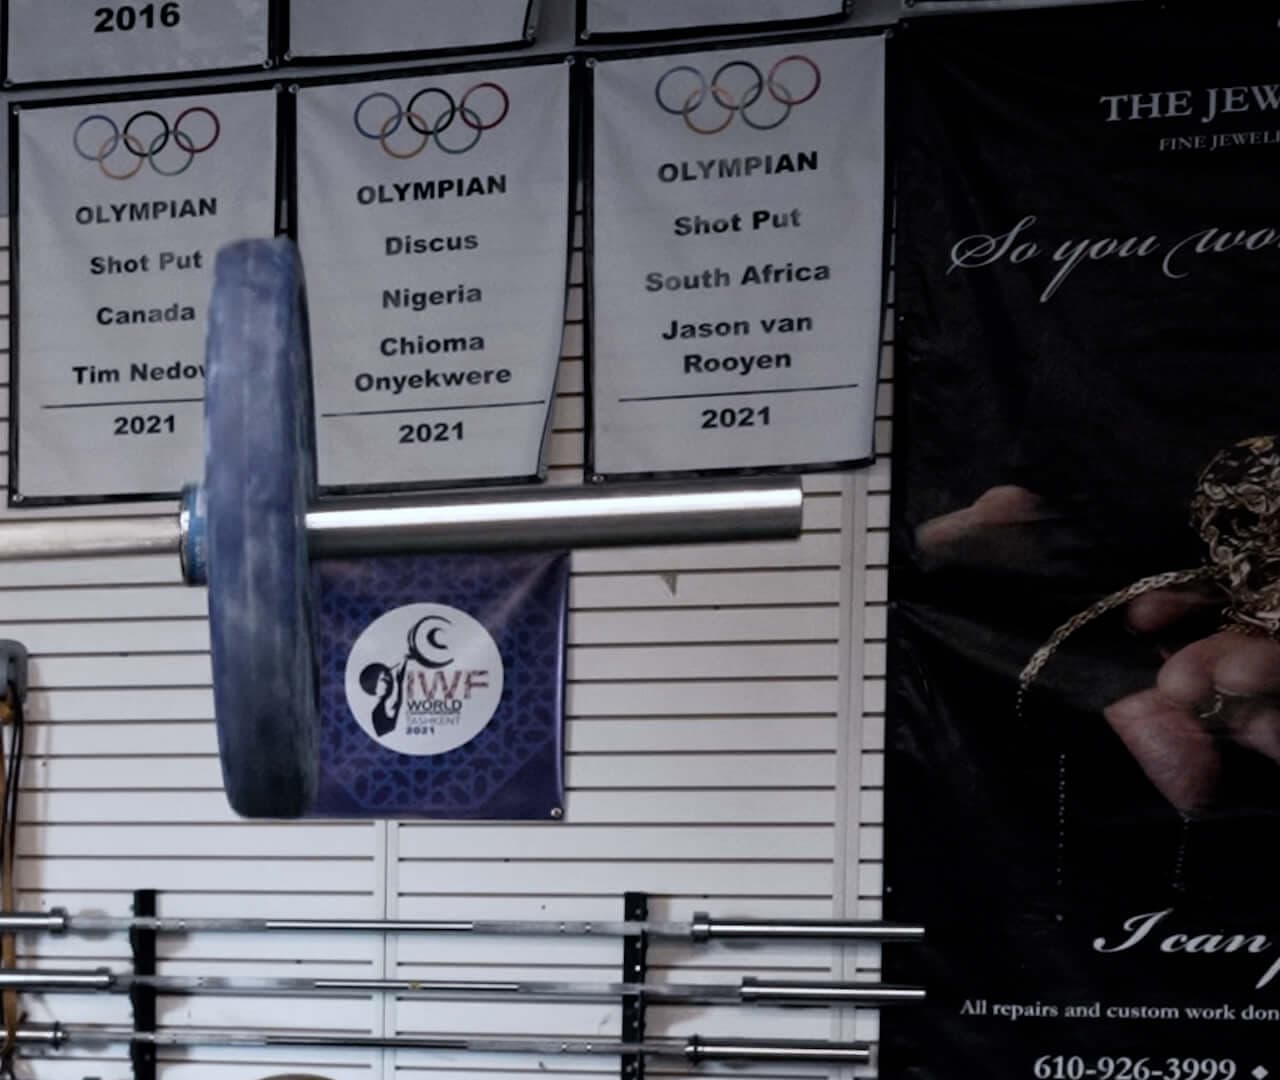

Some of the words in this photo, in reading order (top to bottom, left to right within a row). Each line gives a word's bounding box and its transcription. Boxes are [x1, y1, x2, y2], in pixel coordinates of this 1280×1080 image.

[93, 1, 181, 33] 2016
[1099, 90, 1193, 122] THE
[1201, 84, 1280, 124] JEW
[1158, 135, 1207, 152] FINE
[658, 150, 818, 183] OLYMPIAN
[357, 174, 507, 205] OLYMPIAN
[75, 197, 217, 225] OLYMPIAN
[673, 213, 742, 237] Shot
[752, 209, 801, 231] Put
[385, 234, 479, 256] Discus
[90, 255, 149, 275] Shot
[159, 250, 203, 271] Put
[944, 213, 1039, 276] So
[1042, 234, 1159, 303] you
[1162, 226, 1280, 280] wo
[645, 267, 731, 293] South
[740, 262, 830, 286] Africa
[382, 284, 482, 312] Nigeria
[95, 303, 196, 326] Canada
[661, 319, 750, 341] Jason
[759, 316, 813, 334] van
[380, 335, 485, 357] Chioma
[71, 365, 120, 385] Tim
[683, 353, 792, 376] Rooyen
[354, 368, 512, 395] Onyekwere
[114, 414, 175, 436] 2021
[701, 405, 770, 430] 2021
[399, 421, 464, 444] 2021
[406, 669, 490, 700] IWF
[407, 699, 463, 712] WORLD
[1091, 906, 1176, 954] I
[1158, 927, 1274, 956] can
[960, 999, 987, 1015] All
[992, 1001, 1059, 1021] repairs
[1064, 1001, 1102, 1020] and
[1106, 1006, 1180, 1019] custom
[1185, 1004, 1236, 1020] work
